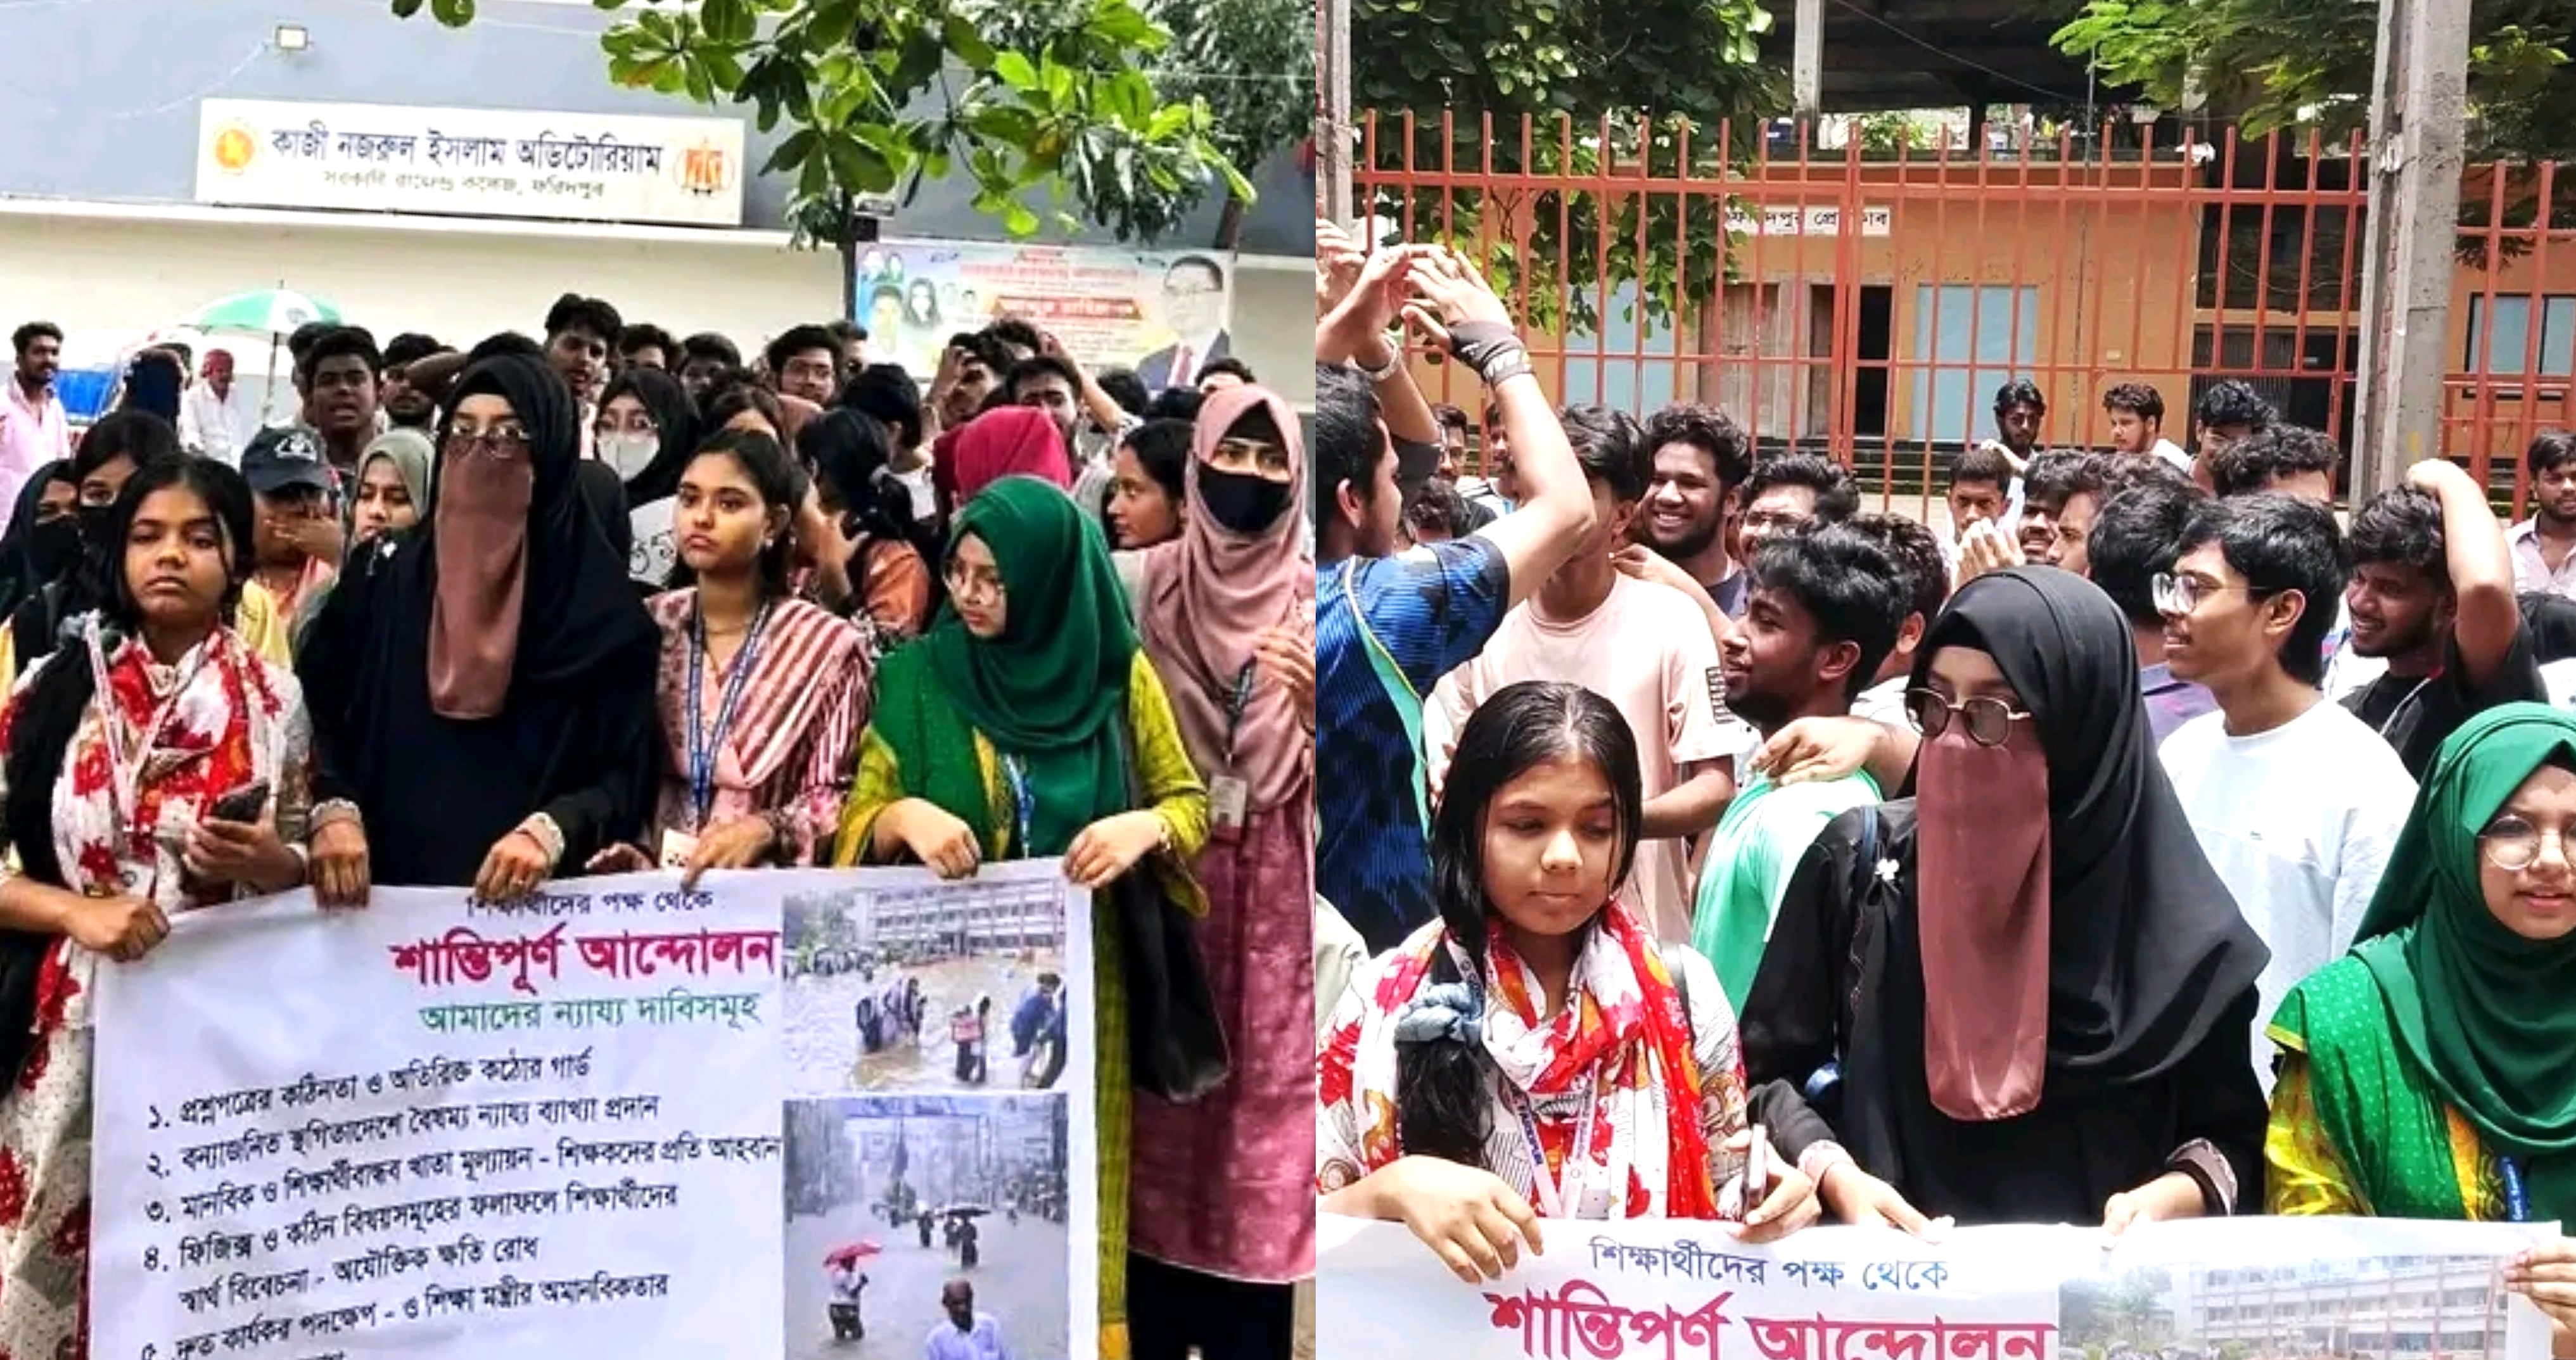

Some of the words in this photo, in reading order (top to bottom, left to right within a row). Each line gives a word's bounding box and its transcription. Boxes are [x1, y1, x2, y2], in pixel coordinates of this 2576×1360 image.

[271, 120, 329, 163] কাজী
[338, 129, 416, 167] নজরুল
[428, 127, 506, 171] ইসলাম
[516, 129, 665, 177] অডিটোরিয়াম
[603, 891, 645, 912] পক্ষ
[653, 890, 714, 911] থেকে
[388, 922, 567, 995] শান্তিপূর্ণ
[575, 927, 780, 979] আন্দোলন
[419, 1000, 544, 1033] আমাদের
[554, 998, 630, 1029] ন্যায্য
[639, 986, 762, 1030] দাবিসমূহ
[148, 1105, 170, 1129] ১.
[178, 1088, 272, 1126] প্রশ্নপত্রের
[279, 1072, 358, 1107] কঠিনতা
[366, 1074, 383, 1093] ও
[389, 1056, 472, 1089] অতিরিক্ত
[480, 1048, 542, 1081] কঠোর
[550, 1045, 593, 1079] গার্ড
[144, 1201, 171, 1223] ৩.
[181, 1181, 256, 1220] মানবিক
[262, 1182, 277, 1204] ও
[408, 1152, 453, 1177] খাতা
[460, 1147, 533, 1181] মূল্যায়ন
[557, 1136, 657, 1167] শিক্ষকদের
[660, 1131, 701, 1162] প্রতি
[146, 1153, 170, 1179] ২.
[408, 1105, 470, 1133] বৈষম্য
[477, 1102, 530, 1129] ন্যায্য
[539, 1098, 599, 1126] ব্যাখ্যা
[604, 1095, 660, 1122] প্রদান
[144, 1246, 168, 1271] ৪.
[179, 1231, 255, 1268] ফিজিক্স
[264, 1230, 277, 1251] ও
[284, 1210, 338, 1245] কঠিন
[343, 1196, 461, 1236] বিষয়সমূহের
[469, 1190, 558, 1217] ফলাফলে
[566, 1177, 679, 1211] শিক্ষার্থীদের
[1588, 1236, 1766, 1285] শিক্ষার্থীদের
[1782, 1262, 1844, 1288] পক্ষ
[1863, 1261, 1948, 1290] থেকে
[179, 1275, 222, 1312] স্বার্থ
[228, 1269, 309, 1304] বিবেচনা
[333, 1245, 430, 1281] অযৌক্তিক
[438, 1233, 485, 1266] ক্ষতি
[494, 1236, 539, 1262] রোধ
[222, 1312, 292, 1351] কার্যকর
[299, 1303, 377, 1335] পদক্ষেপ
[404, 1299, 418, 1319] ও
[424, 1285, 474, 1316] শিক্ষা
[481, 1274, 533, 1308] মন্ত্রীর
[540, 1270, 670, 1303] অমানবিকতার
[1482, 1279, 1735, 1360] শান্তিপর্ণ
[1745, 1311, 2058, 1360] আন্দোলন
